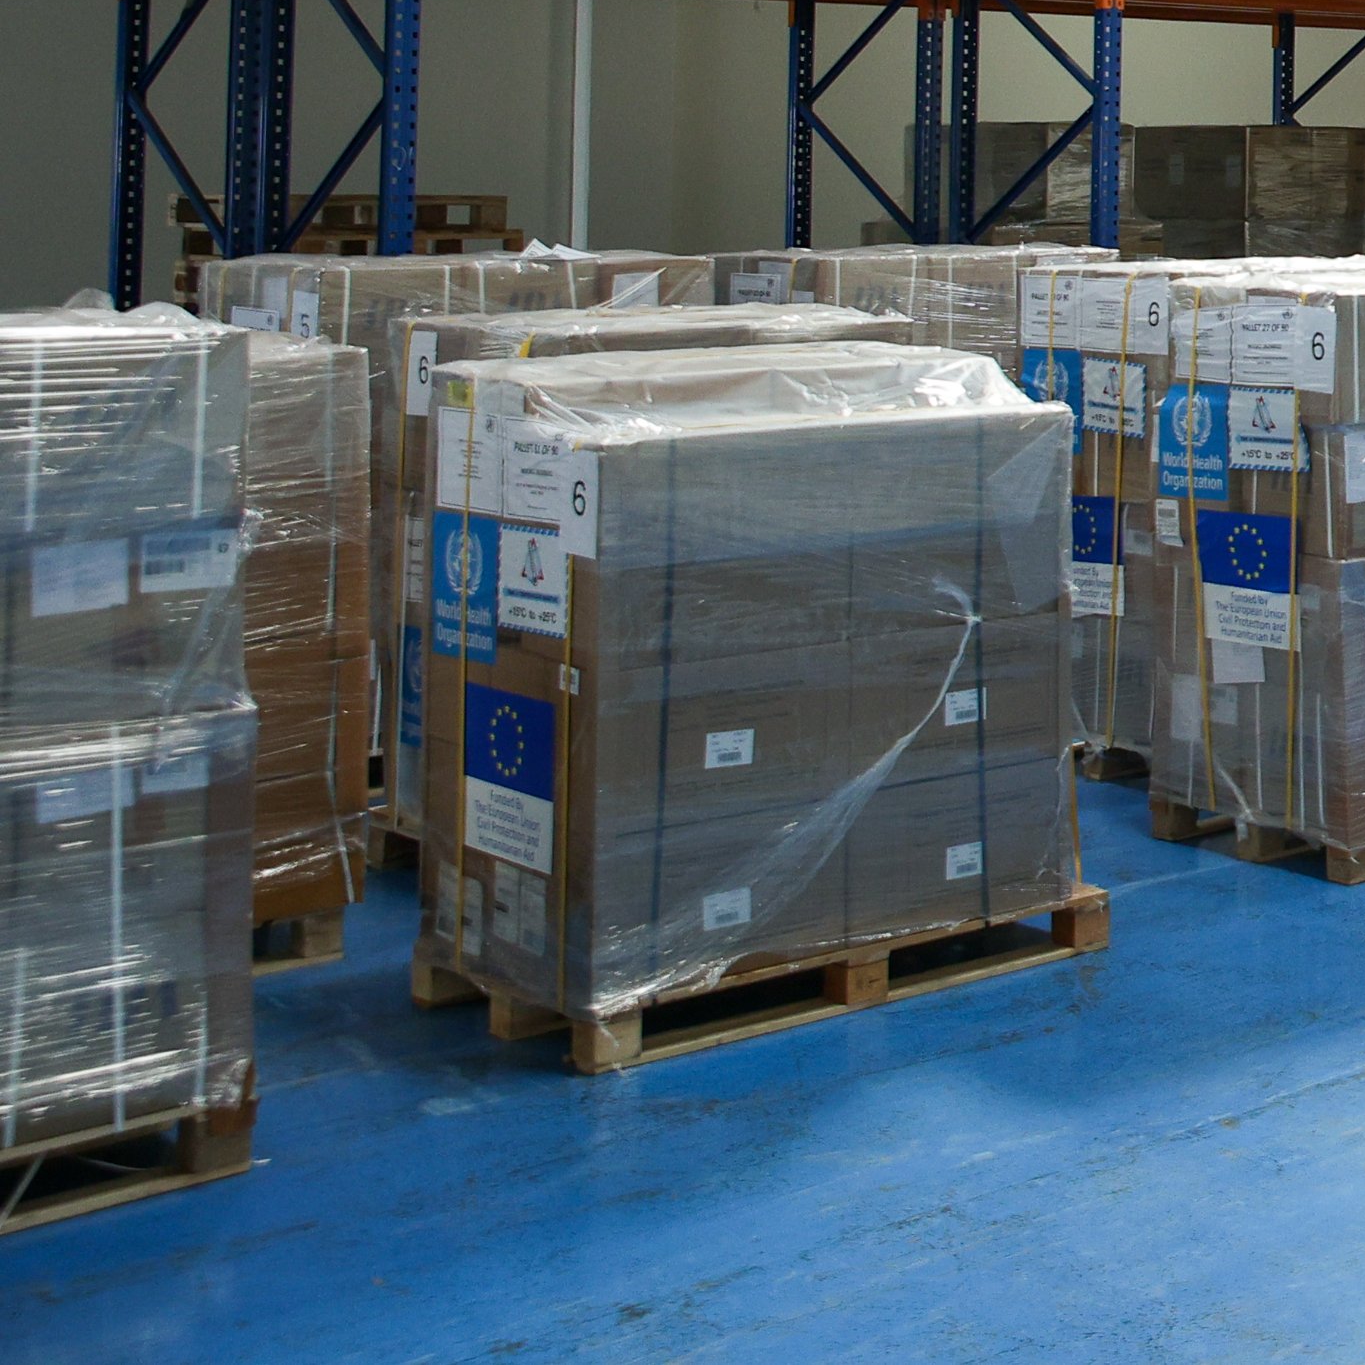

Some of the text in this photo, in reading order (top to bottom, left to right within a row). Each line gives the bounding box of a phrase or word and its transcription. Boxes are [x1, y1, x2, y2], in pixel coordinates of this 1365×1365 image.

[1149, 302, 1159, 326] 6
[301, 314, 310, 339] 5
[1312, 332, 1325, 360] 6
[419, 356, 429, 383] 6
[1163, 452, 1188, 464] World
[573, 481, 586, 516] 6
[1232, 591, 1256, 603] Funded
[1216, 601, 1286, 619] The European Union
[1235, 615, 1270, 630] Protection
[1272, 623, 1286, 632] and
